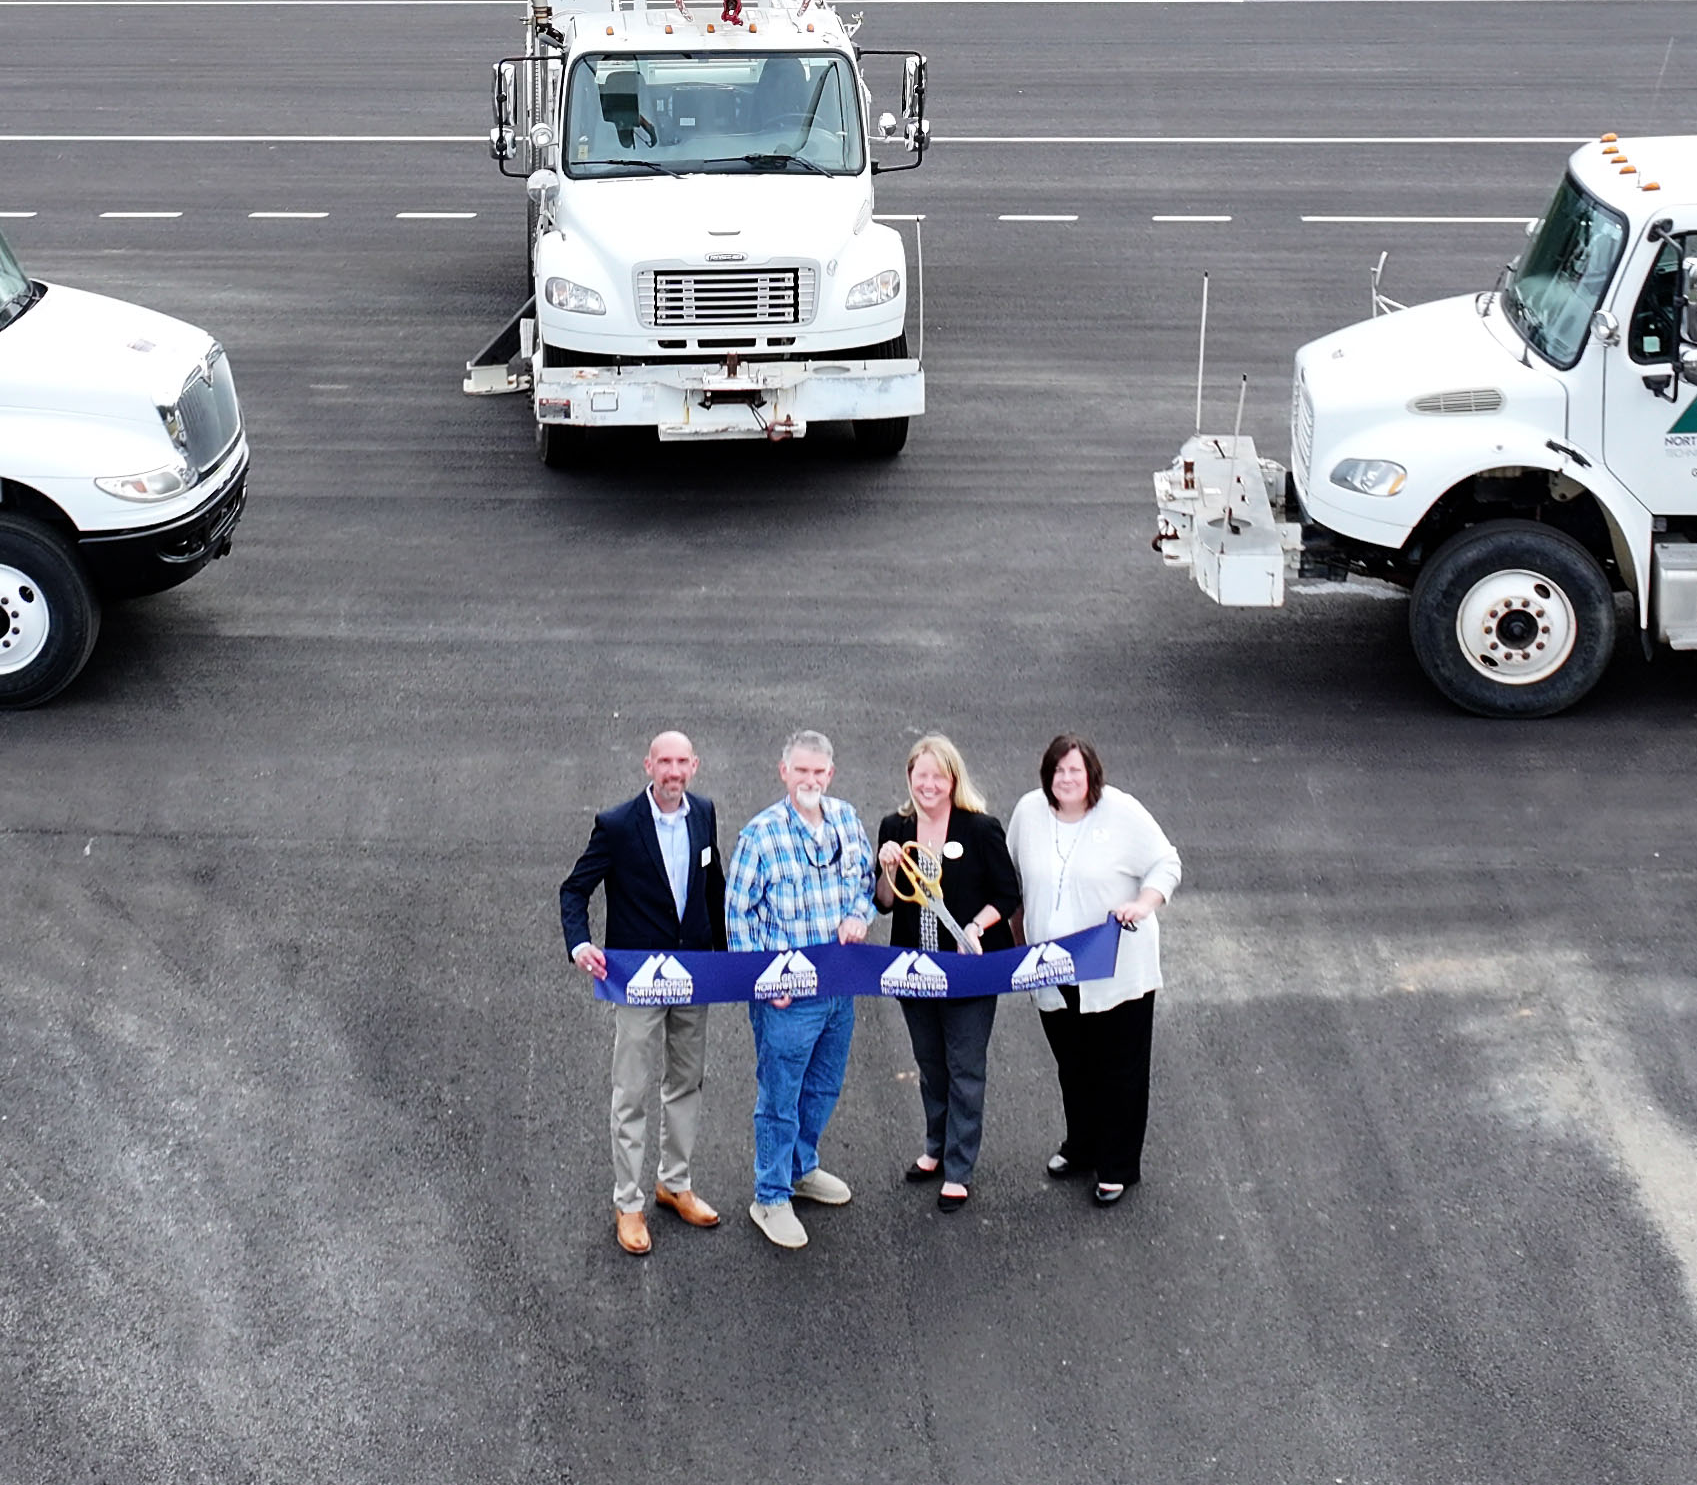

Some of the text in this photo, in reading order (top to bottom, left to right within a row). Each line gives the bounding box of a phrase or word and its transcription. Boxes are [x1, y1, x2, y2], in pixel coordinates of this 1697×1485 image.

[653, 978, 692, 988] GEORGIA
[881, 978, 947, 991] NORTHWESTERN
[627, 987, 693, 996] NORTHWESTERN
